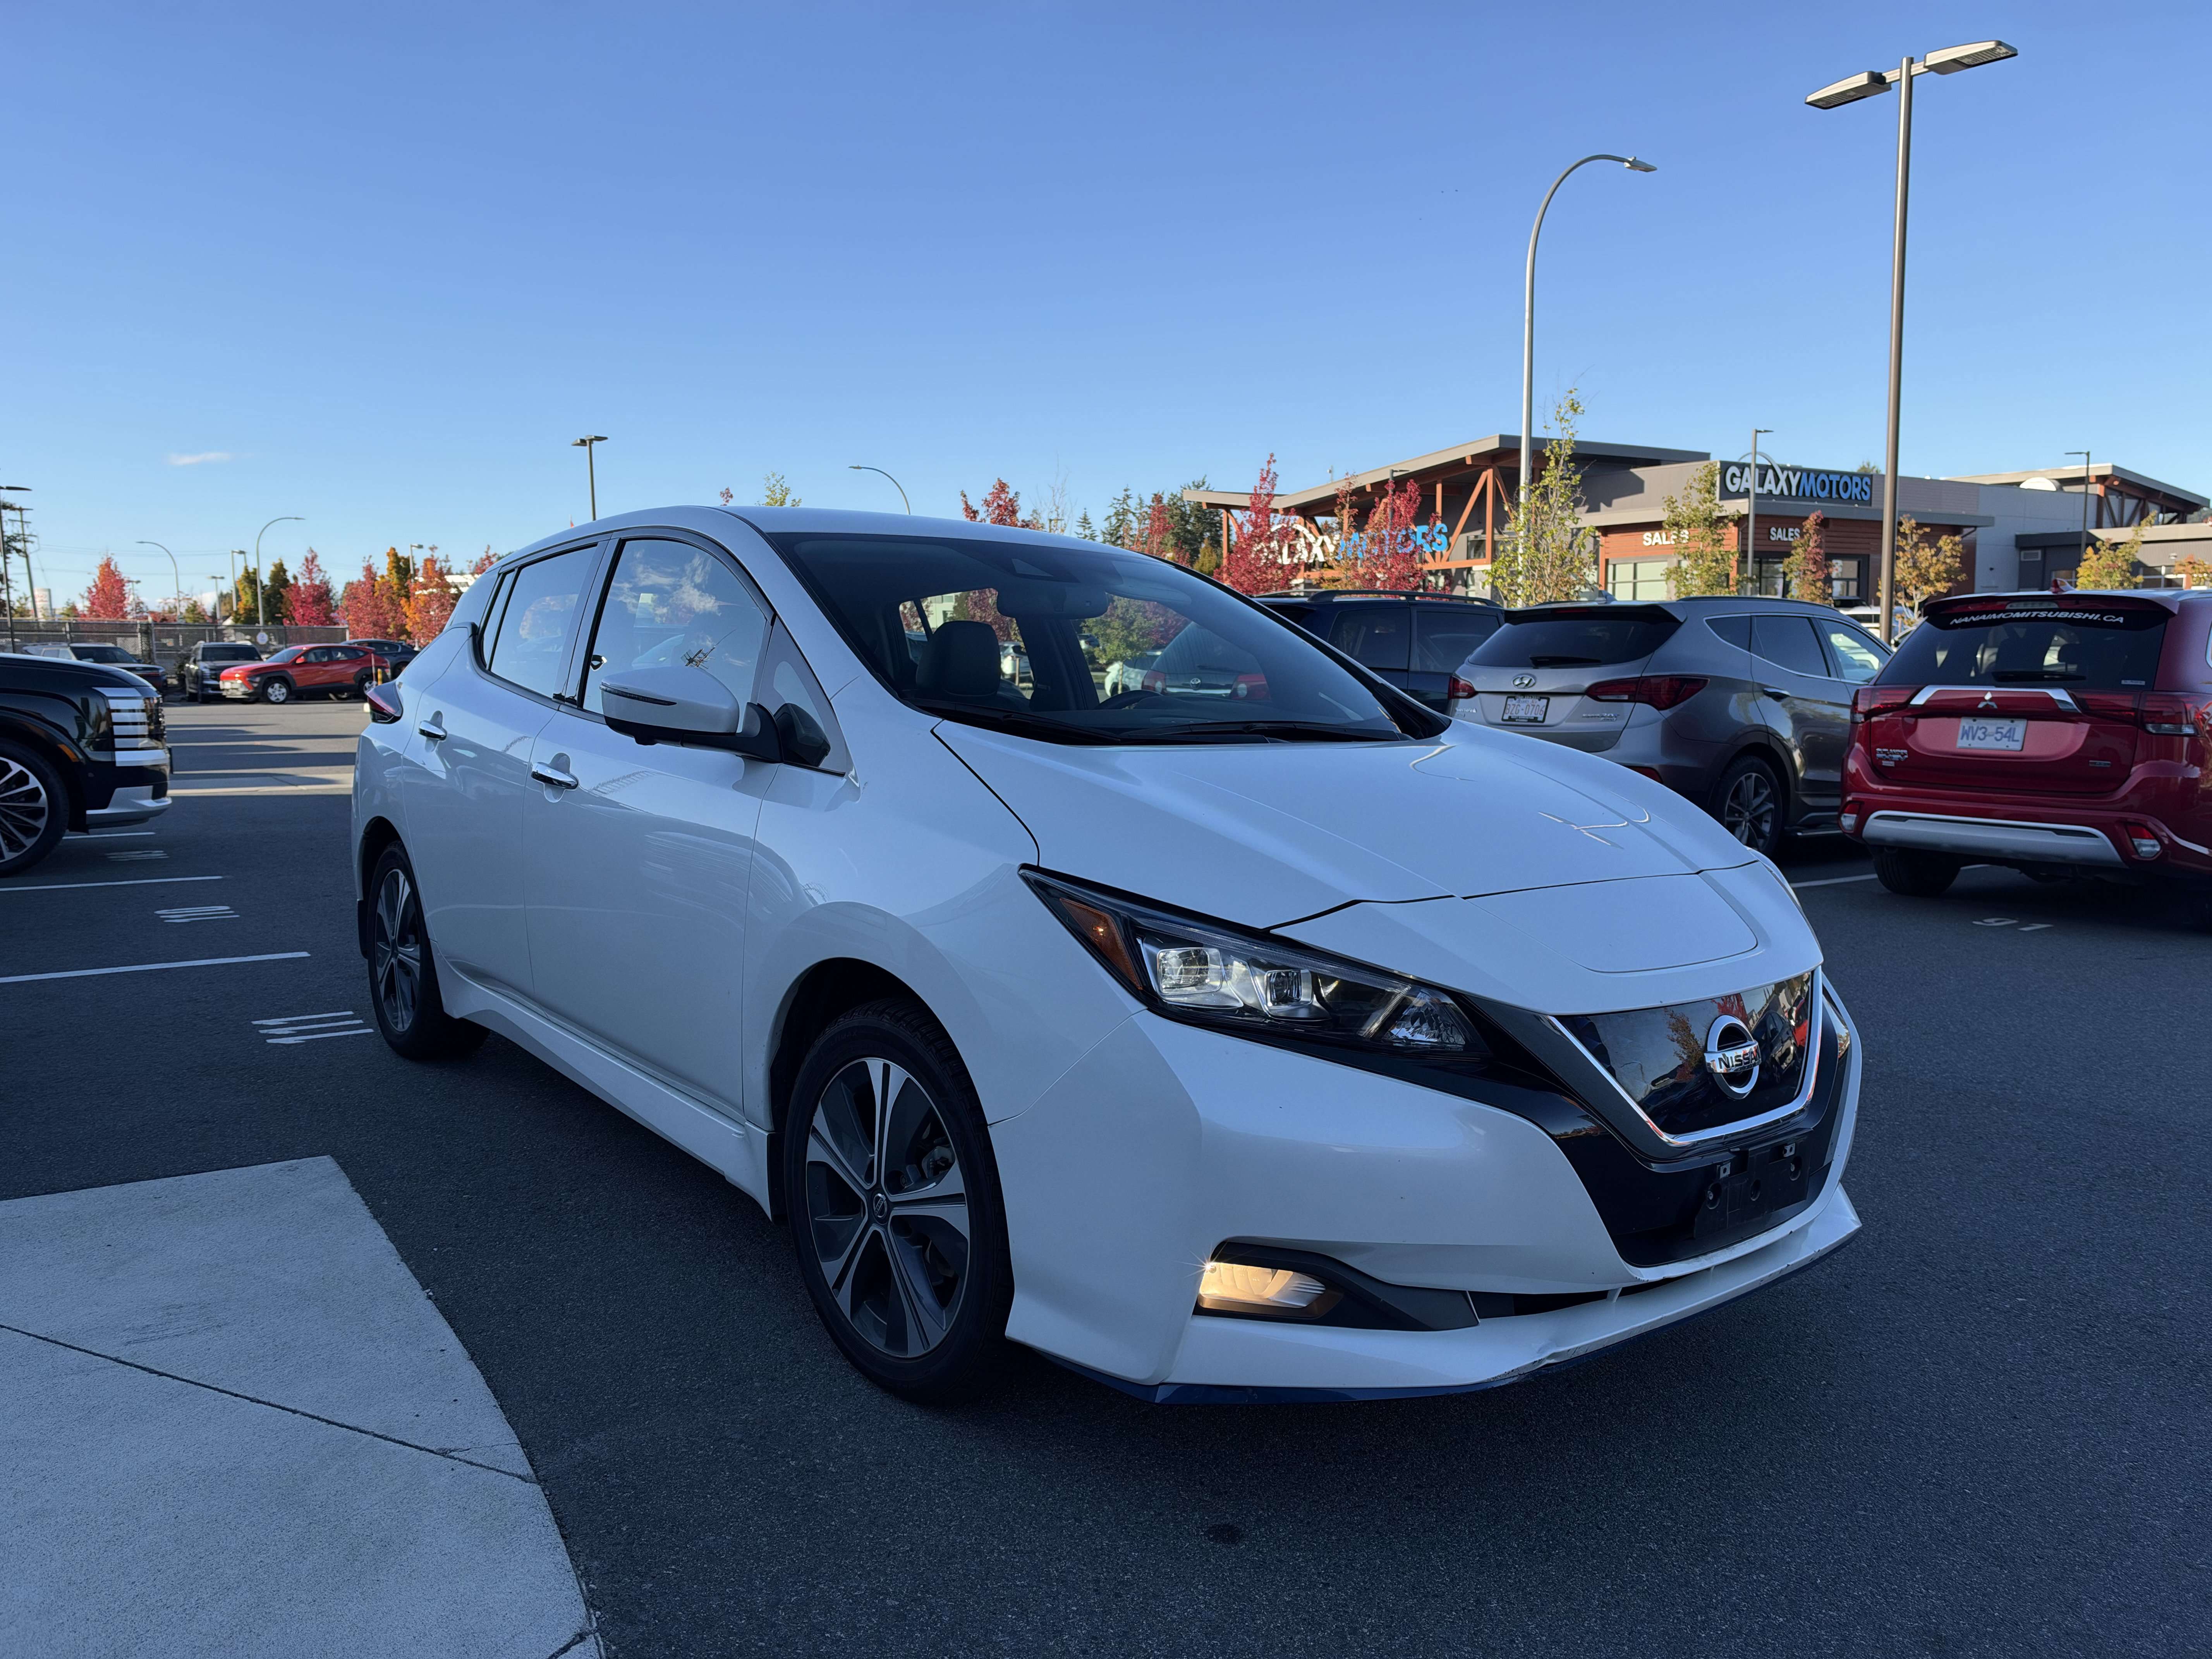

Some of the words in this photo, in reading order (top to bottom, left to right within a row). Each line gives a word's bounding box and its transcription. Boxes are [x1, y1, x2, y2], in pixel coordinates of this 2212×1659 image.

[1770, 527, 1800, 541] SALES
[1949, 611, 2124, 625] NANAIMOMITSUBISHI.CA
[1960, 725, 1987, 741] WV3
[1994, 727, 2020, 742] 54L
[252, 1011, 374, 1044] 111
